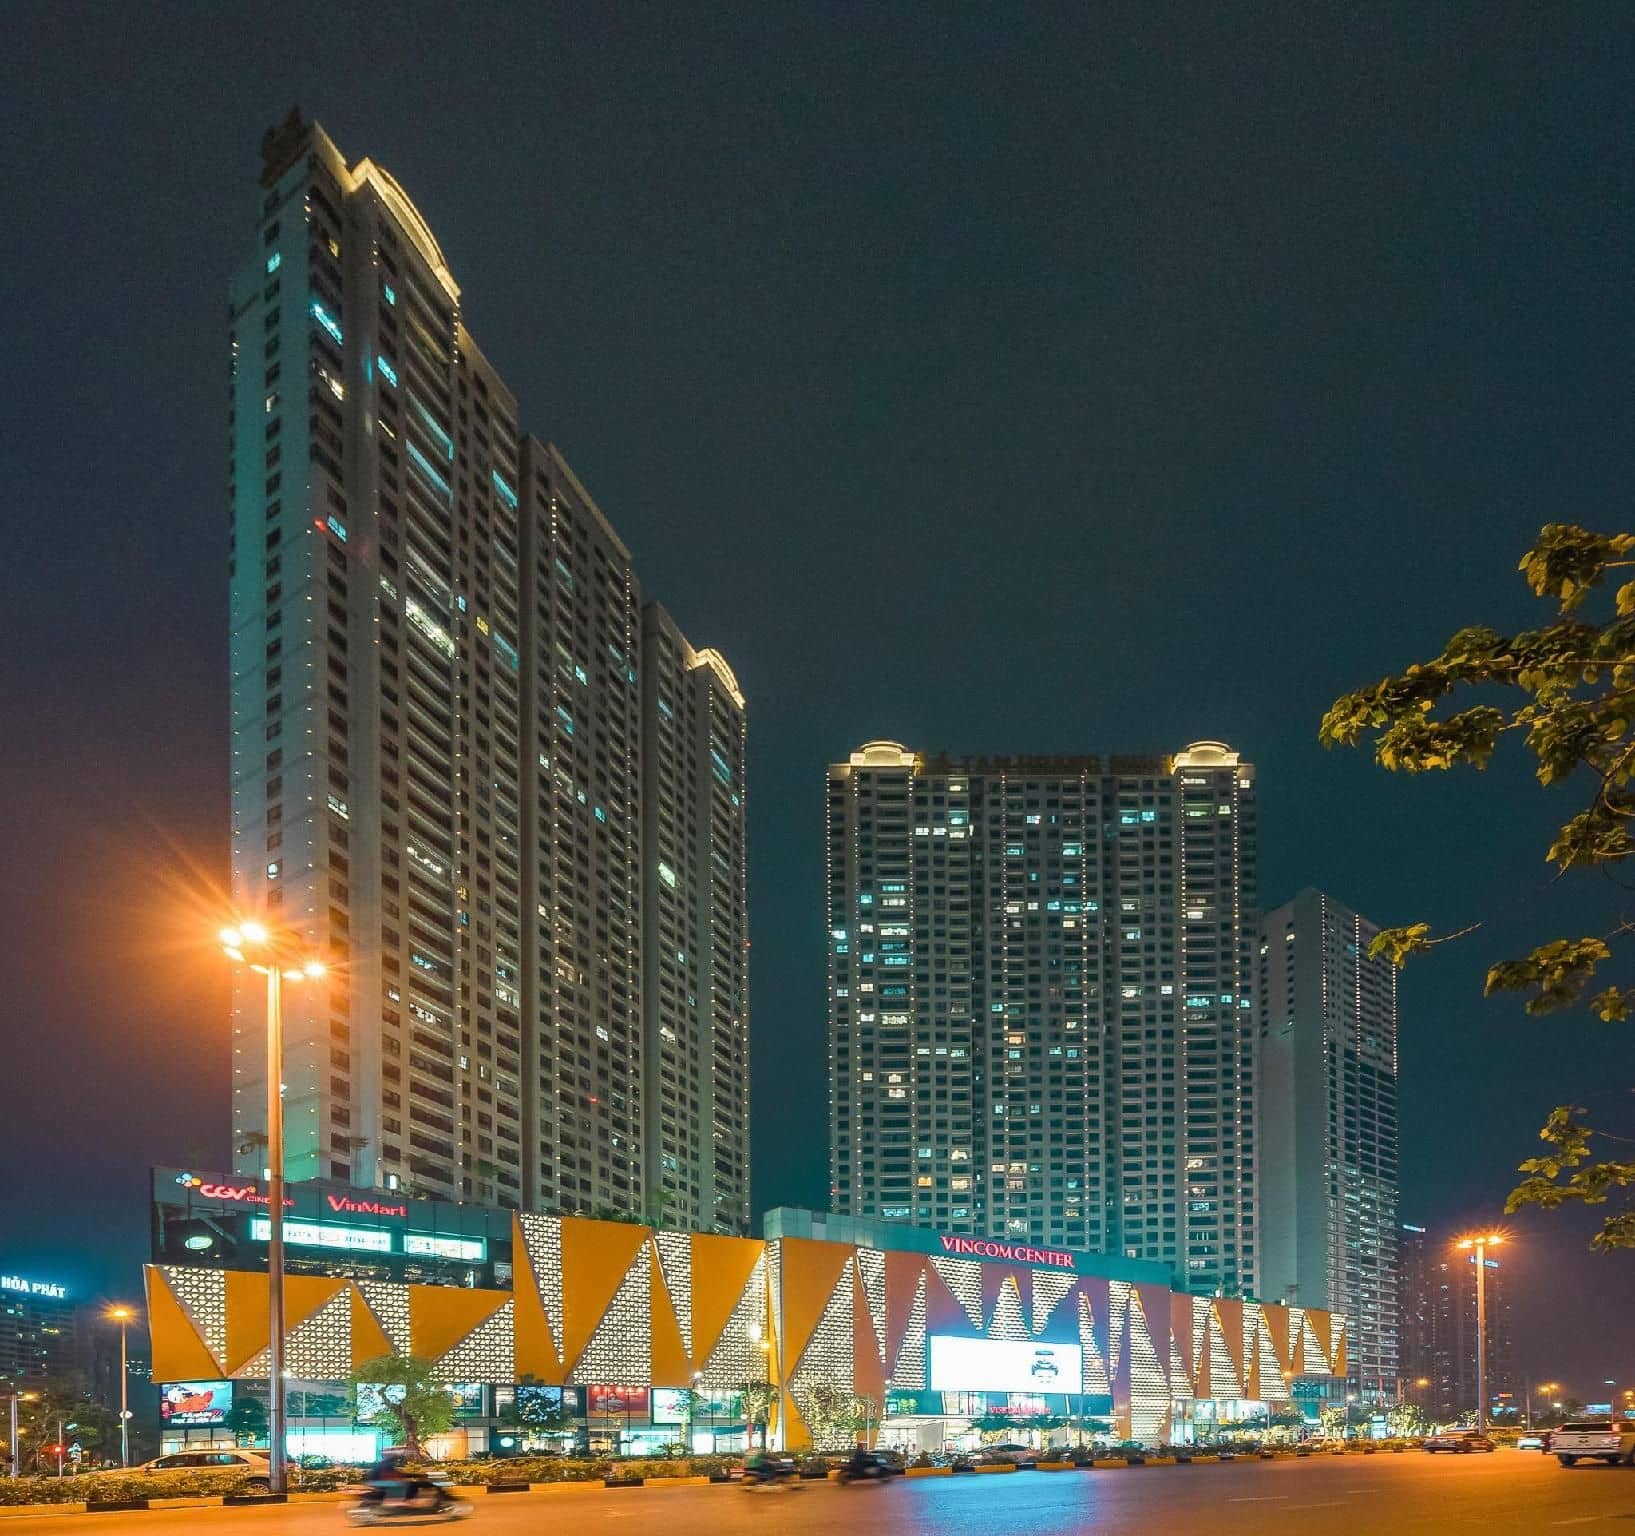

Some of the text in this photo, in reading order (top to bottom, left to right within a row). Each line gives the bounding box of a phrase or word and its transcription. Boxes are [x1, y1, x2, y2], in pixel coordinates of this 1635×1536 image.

[199, 1184, 248, 1201] CGV
[327, 1194, 407, 1217] VinMart
[940, 1236, 1075, 1268] VINCOM CENTER
